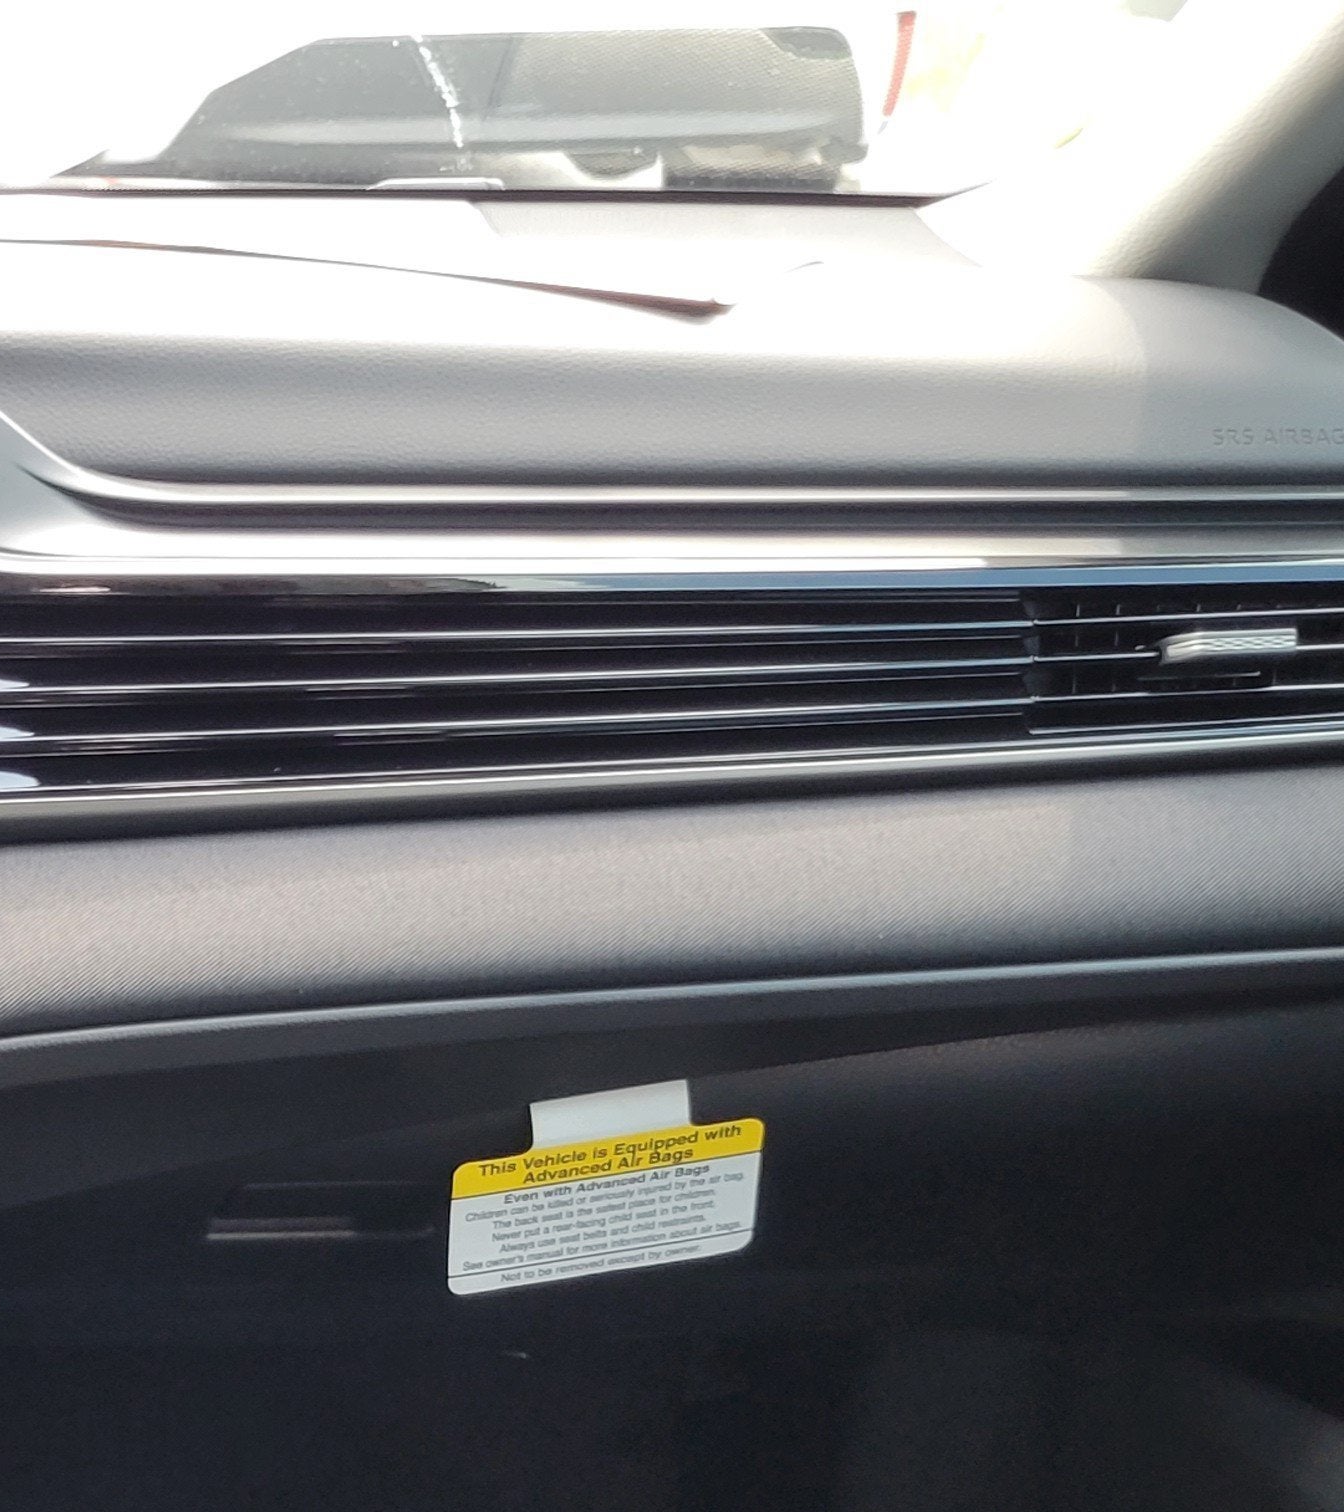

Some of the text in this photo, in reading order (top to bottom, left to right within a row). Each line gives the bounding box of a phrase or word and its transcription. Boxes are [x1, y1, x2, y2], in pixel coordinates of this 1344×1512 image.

[1212, 428, 1253, 445] SRS
[479, 1124, 741, 1176] This Vehicle is Equipped with
[523, 1148, 694, 1184] Advanced Air Bags
[465, 1208, 508, 1222] Children
[511, 1206, 529, 1215] can
[531, 1203, 545, 1212] be
[547, 1198, 574, 1210] killed
[576, 1196, 586, 1205] or
[637, 1182, 672, 1196] injured
[674, 1180, 687, 1191] by
[689, 1177, 706, 1187] the
[709, 1174, 721, 1185] air
[504, 1164, 710, 1205] Even with Advanced Air Bags
[491, 1230, 522, 1242] Never
[524, 1227, 541, 1239] put
[543, 1226, 550, 1234] a
[552, 1217, 606, 1233] rear-facing
[608, 1212, 633, 1224] child
[671, 1205, 688, 1215] the
[493, 1219, 512, 1229] The
[514, 1216, 538, 1227] back
[541, 1212, 563, 1223] seat
[576, 1207, 593, 1217] the
[499, 1241, 535, 1254] Always
[537, 1238, 556, 1248] use
[559, 1233, 581, 1244] seat
[583, 1229, 607, 1241] belts
[609, 1226, 629, 1236] and
[631, 1221, 656, 1233] child
[463, 1261, 483, 1272] See
[500, 1272, 521, 1282] Not
[524, 1269, 535, 1280] to
[537, 1267, 553, 1277] be
[555, 1258, 605, 1274] removed
[647, 1250, 661, 1260] by
